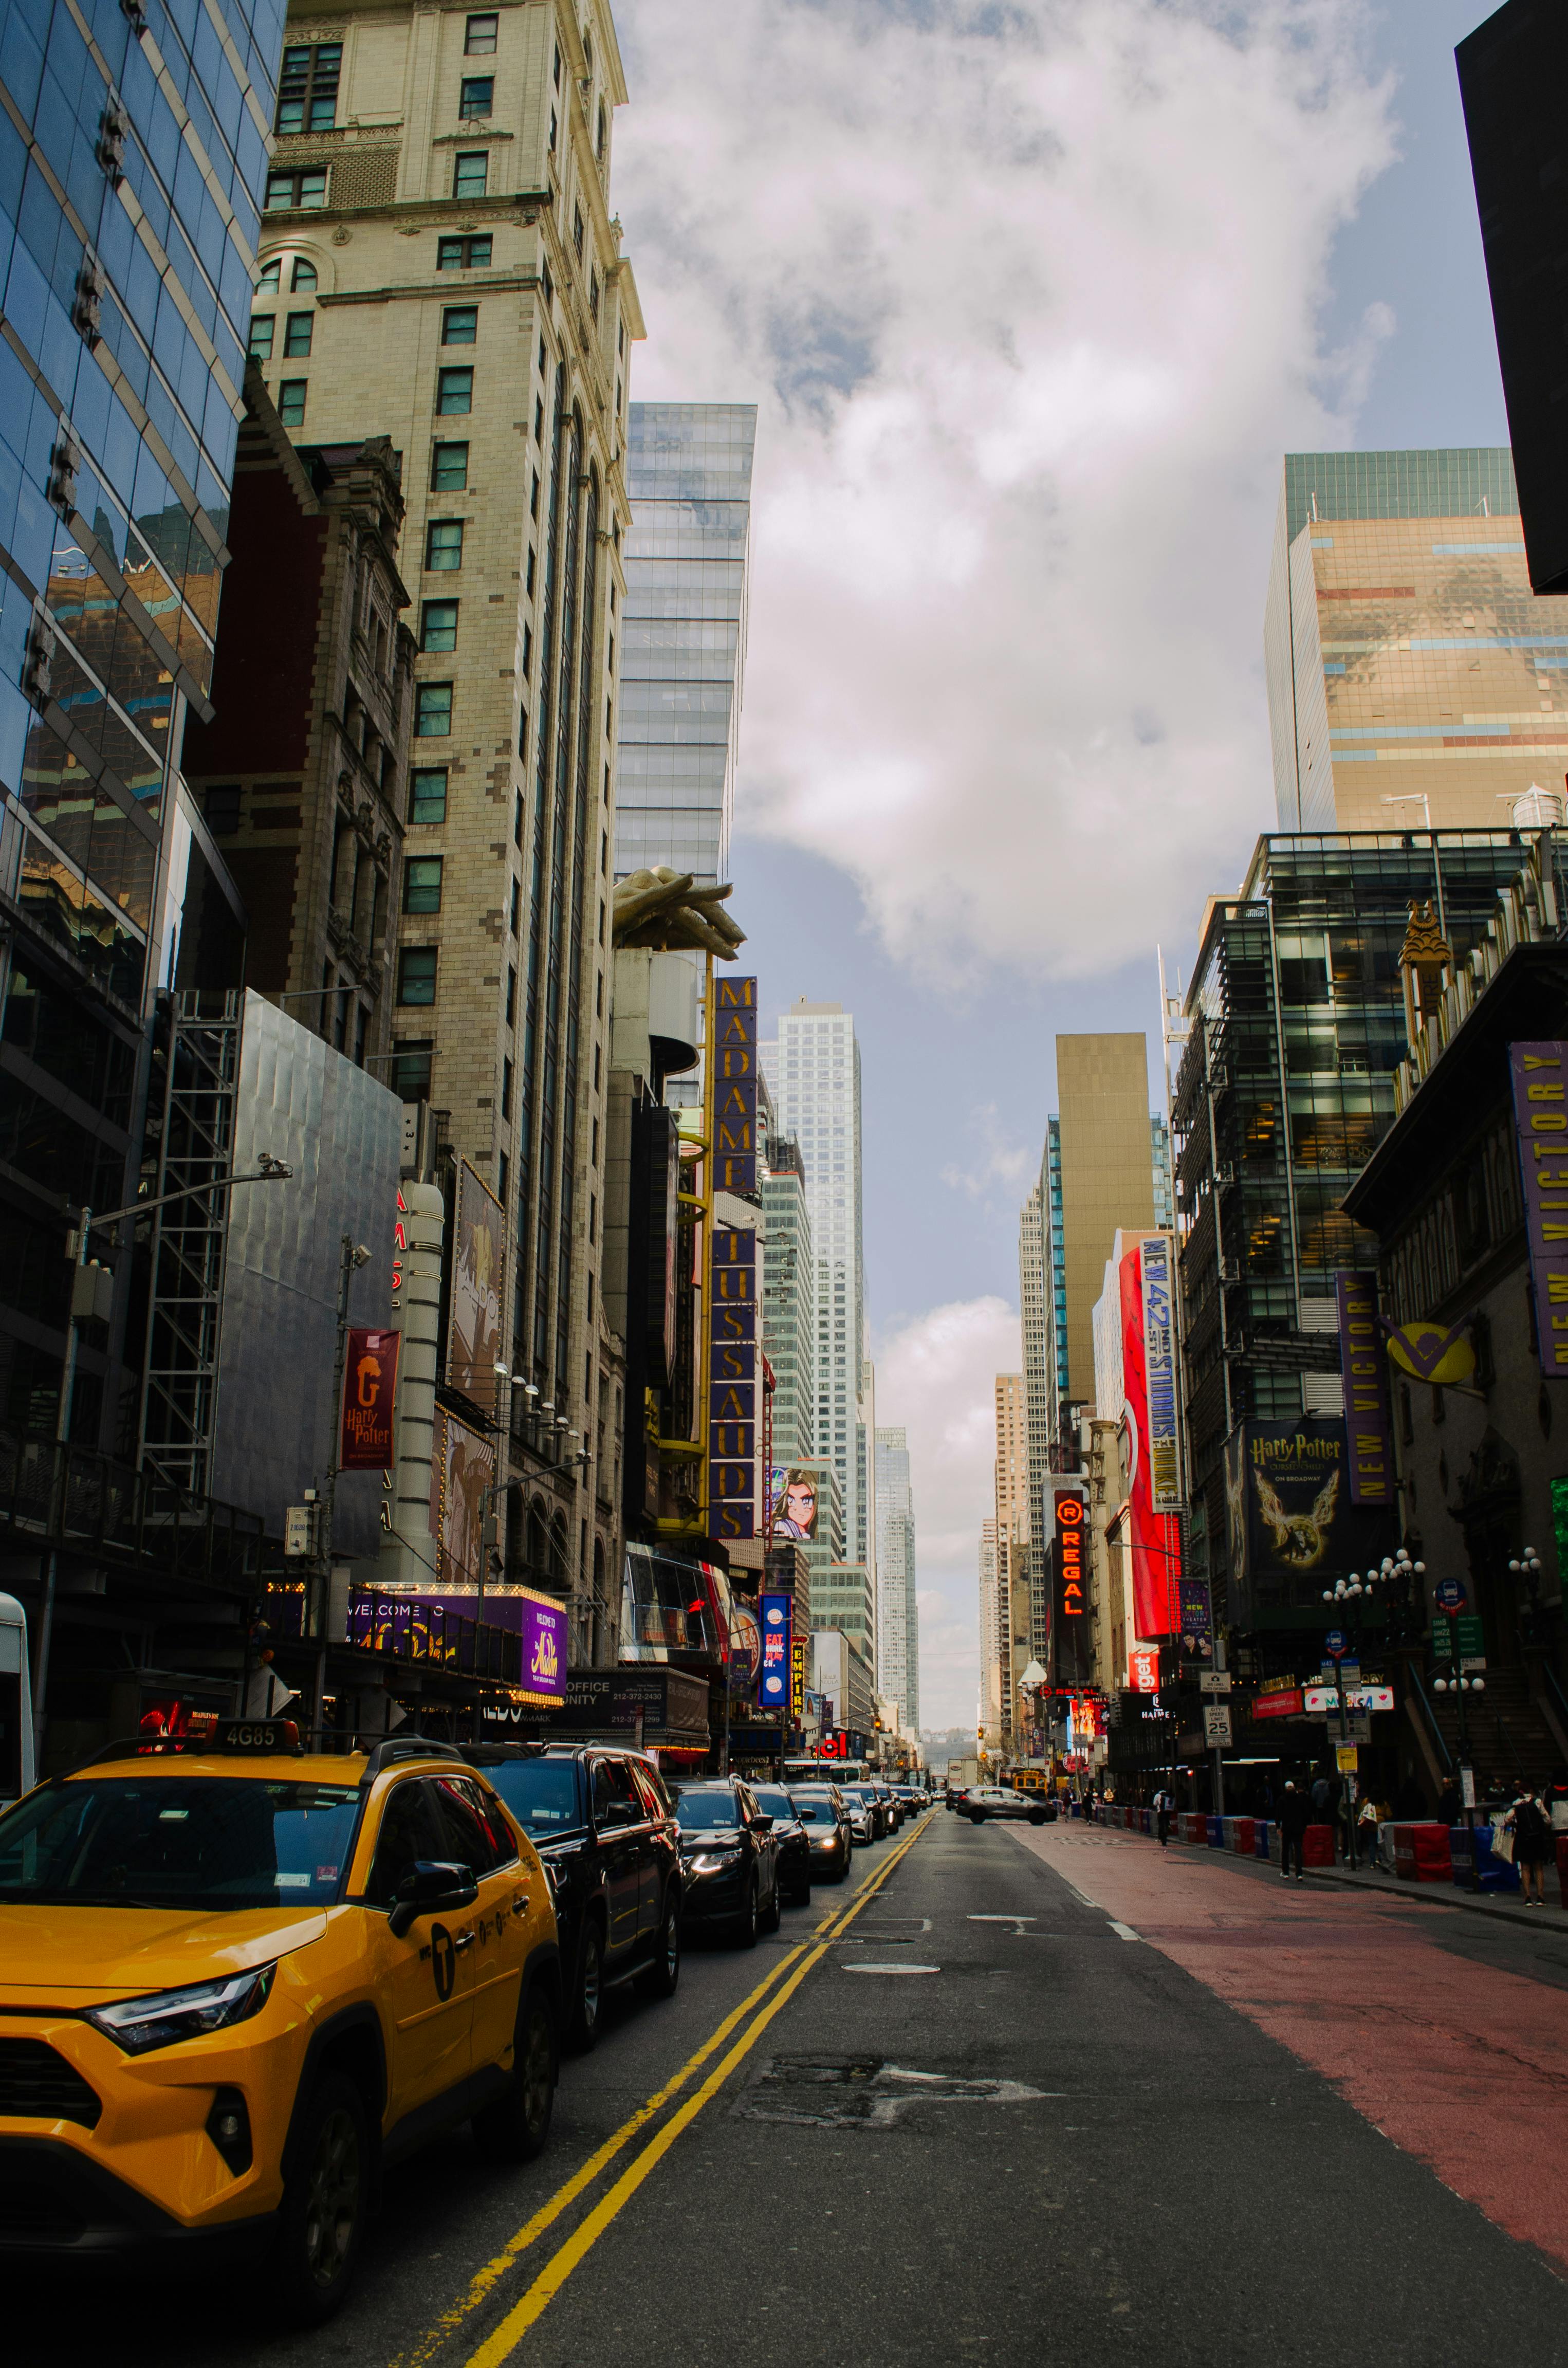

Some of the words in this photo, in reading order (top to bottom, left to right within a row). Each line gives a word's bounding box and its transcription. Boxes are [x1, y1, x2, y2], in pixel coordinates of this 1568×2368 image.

[1425, 971, 1438, 1016] ATRE
[718, 979, 753, 1186] MADAME
[1144, 1240, 1168, 1280] NEW
[1345, 1280, 1380, 1412] VICTORY
[716, 1232, 747, 1535] TUSSAUD'S
[1149, 1355, 1175, 1438] STUDIOS
[345, 1407, 378, 1431] Harry
[355, 1425, 390, 1447] Potter
[1250, 1437, 1295, 1465] Harry
[1295, 1433, 1340, 1465] Potter
[1356, 1434, 1386, 1497] NEW
[1153, 1447, 1178, 1495] DUKE
[1062, 1532, 1083, 1616] REGAL
[537, 1612, 551, 1627] WELCOME
[551, 1618, 556, 1628] TO
[531, 1631, 558, 1678] Aladdin
[1135, 1656, 1155, 1692] rget
[566, 1681, 610, 1693] OFFICE
[793, 1649, 802, 1716] EMPIRE
[226, 1725, 274, 1746] 4G85
[1208, 1722, 1228, 1734] 25
[419, 1944, 432, 1961] NYC
